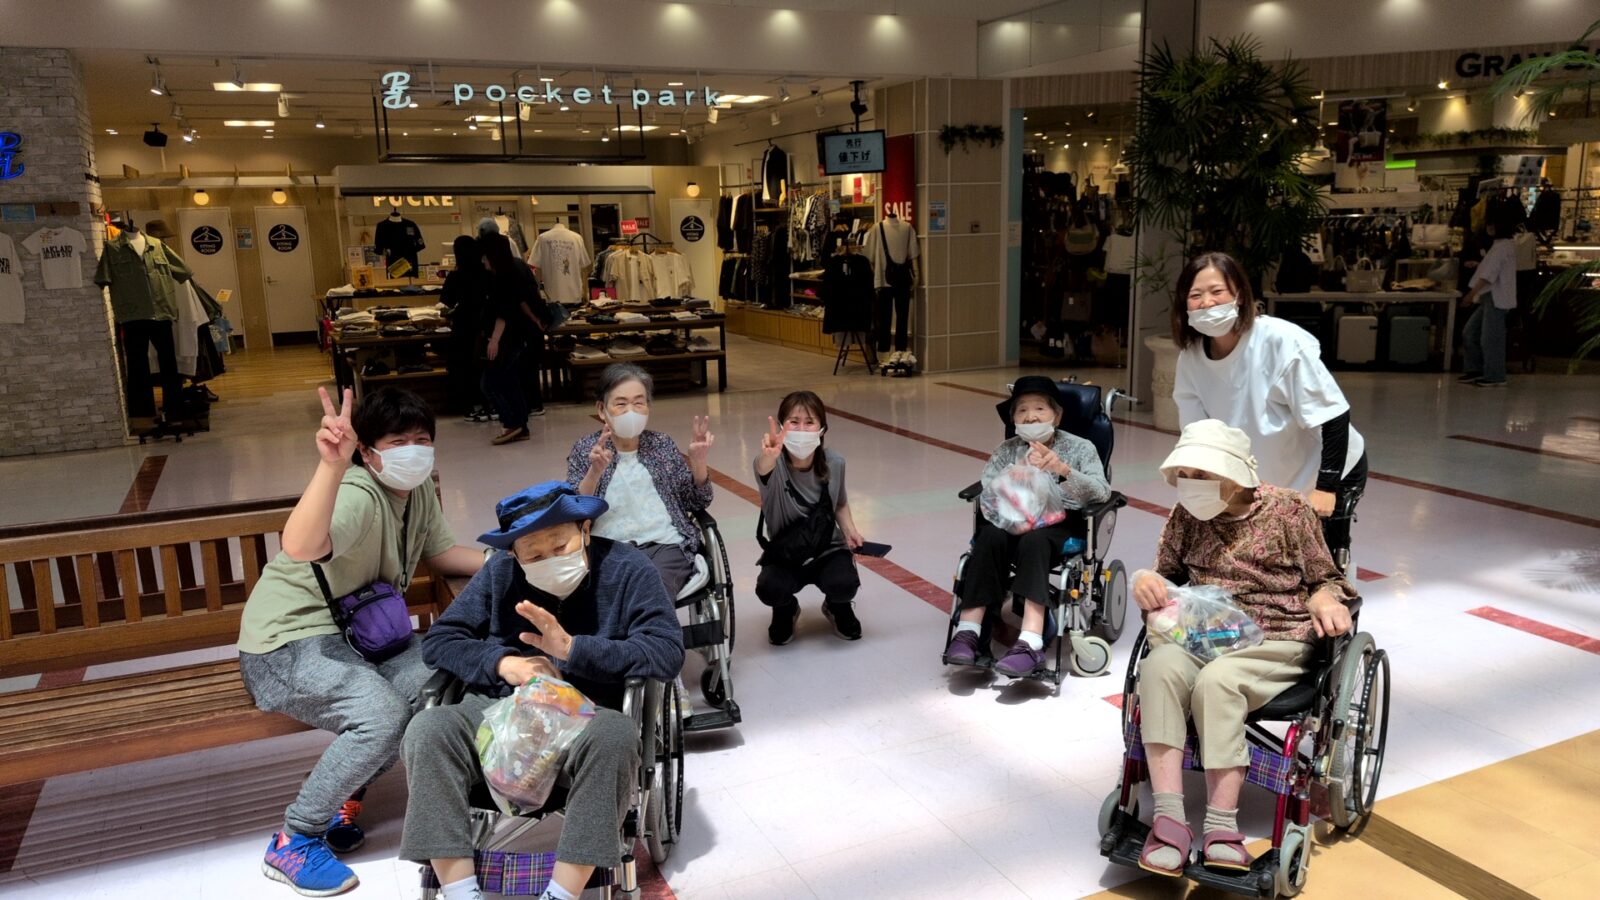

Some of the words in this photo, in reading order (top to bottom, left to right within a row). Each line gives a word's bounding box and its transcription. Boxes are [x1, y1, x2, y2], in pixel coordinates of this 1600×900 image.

[454, 81, 613, 105] pocket
[632, 86, 720, 110] park
[838, 150, 871, 162] 値下げ
[884, 201, 912, 221] SALE
